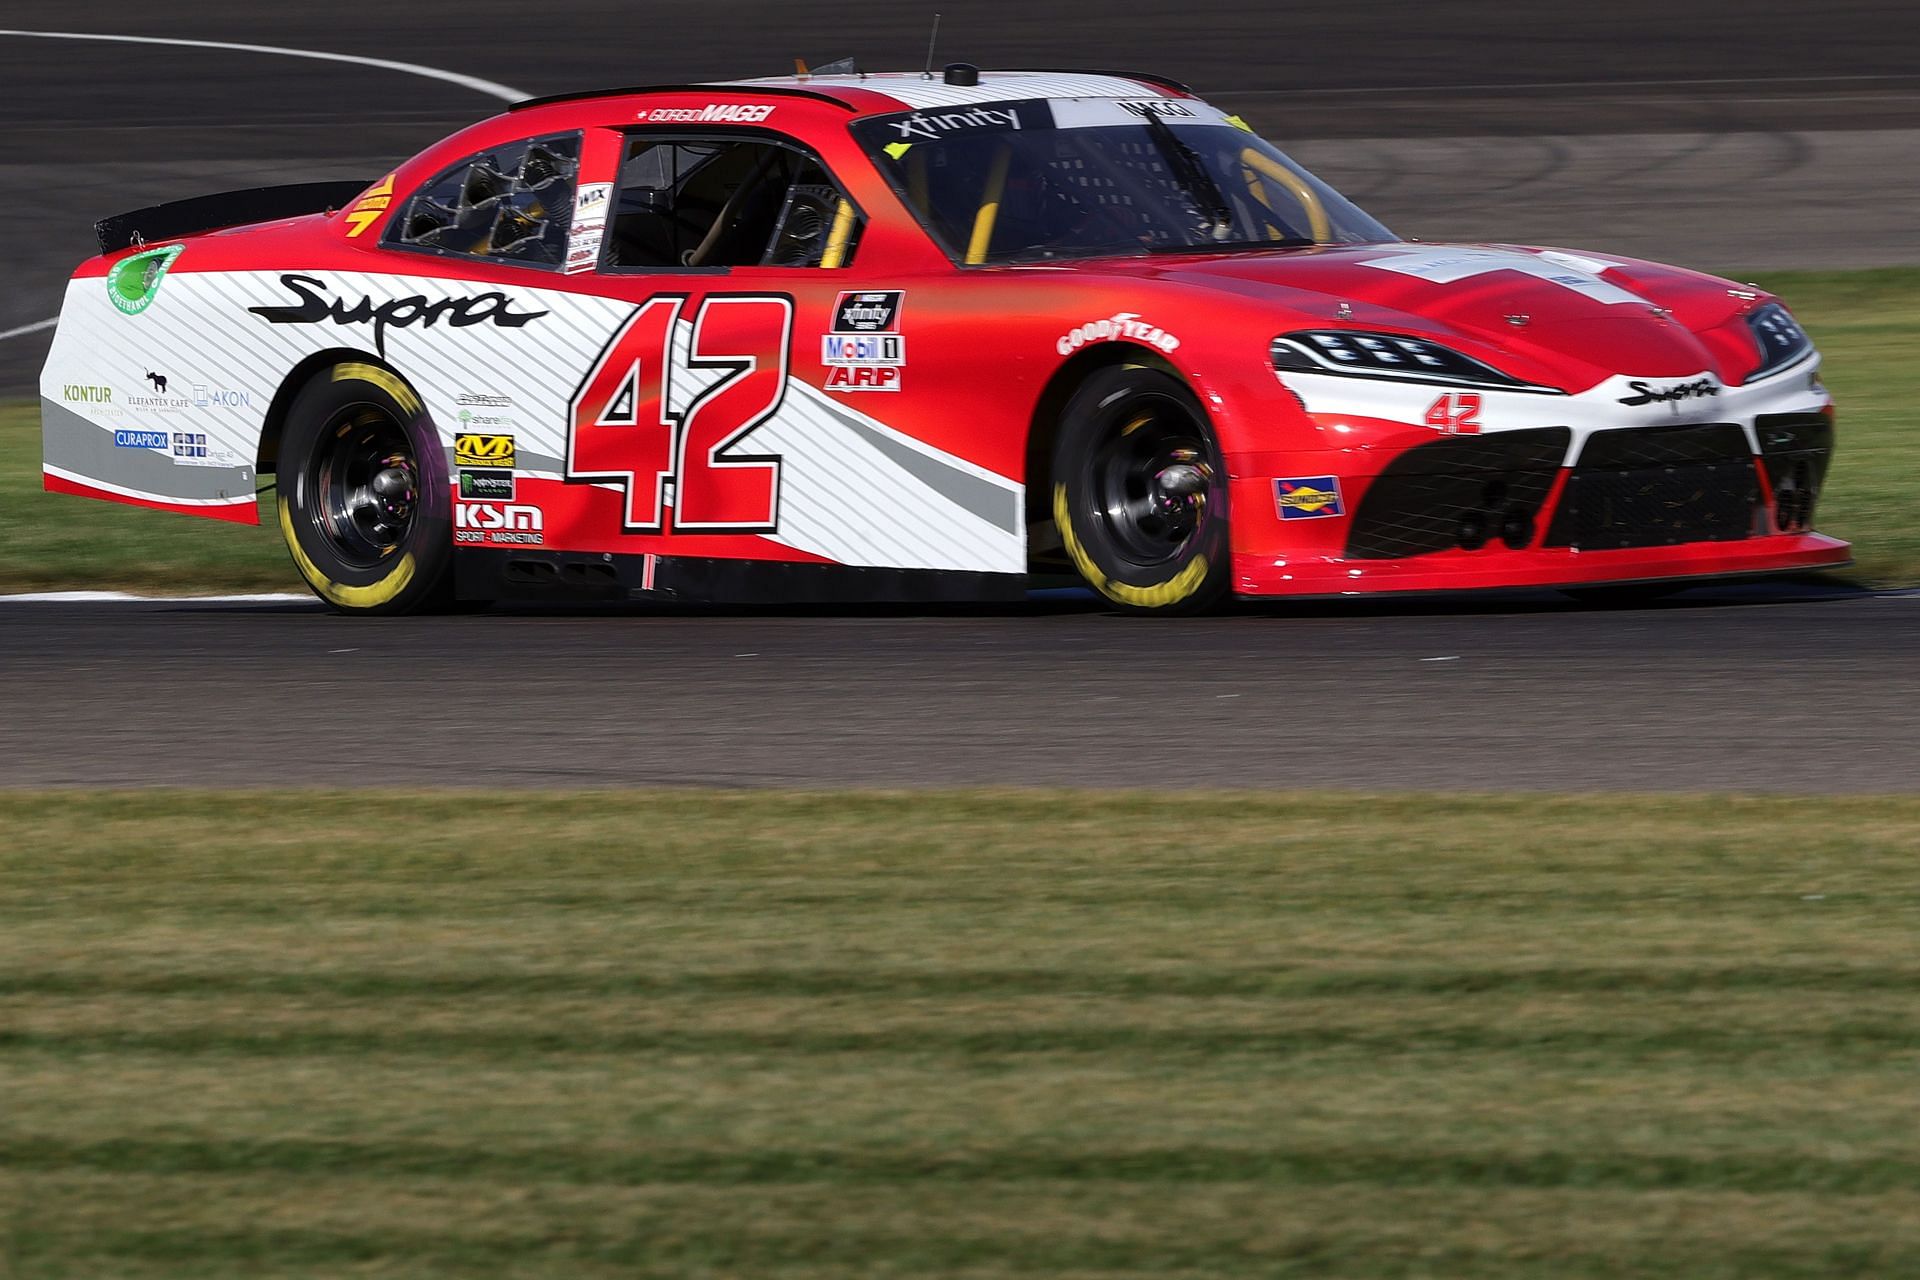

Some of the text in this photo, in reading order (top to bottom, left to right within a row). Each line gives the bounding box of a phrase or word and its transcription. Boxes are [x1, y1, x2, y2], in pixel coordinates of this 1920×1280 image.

[699, 104, 776, 122] MAGGI
[888, 107, 1021, 139] xfinity
[248, 274, 550, 360] Supra
[842, 303, 892, 325] xfinity
[1056, 312, 1180, 355] GOODYEAR
[827, 336, 898, 358] Mobil 1
[830, 367, 895, 386] ARP
[64, 384, 112, 403] KONTUR
[128, 397, 168, 408] ELEFANTEN
[212, 390, 249, 407] AKON
[1617, 378, 1720, 416] Supra
[564, 292, 795, 535] 42
[1424, 392, 1485, 435] 42
[116, 432, 168, 447] CURAPROX
[455, 503, 544, 531] KSM
[456, 531, 485, 542] SPORT
[491, 532, 544, 545] MARKETING
